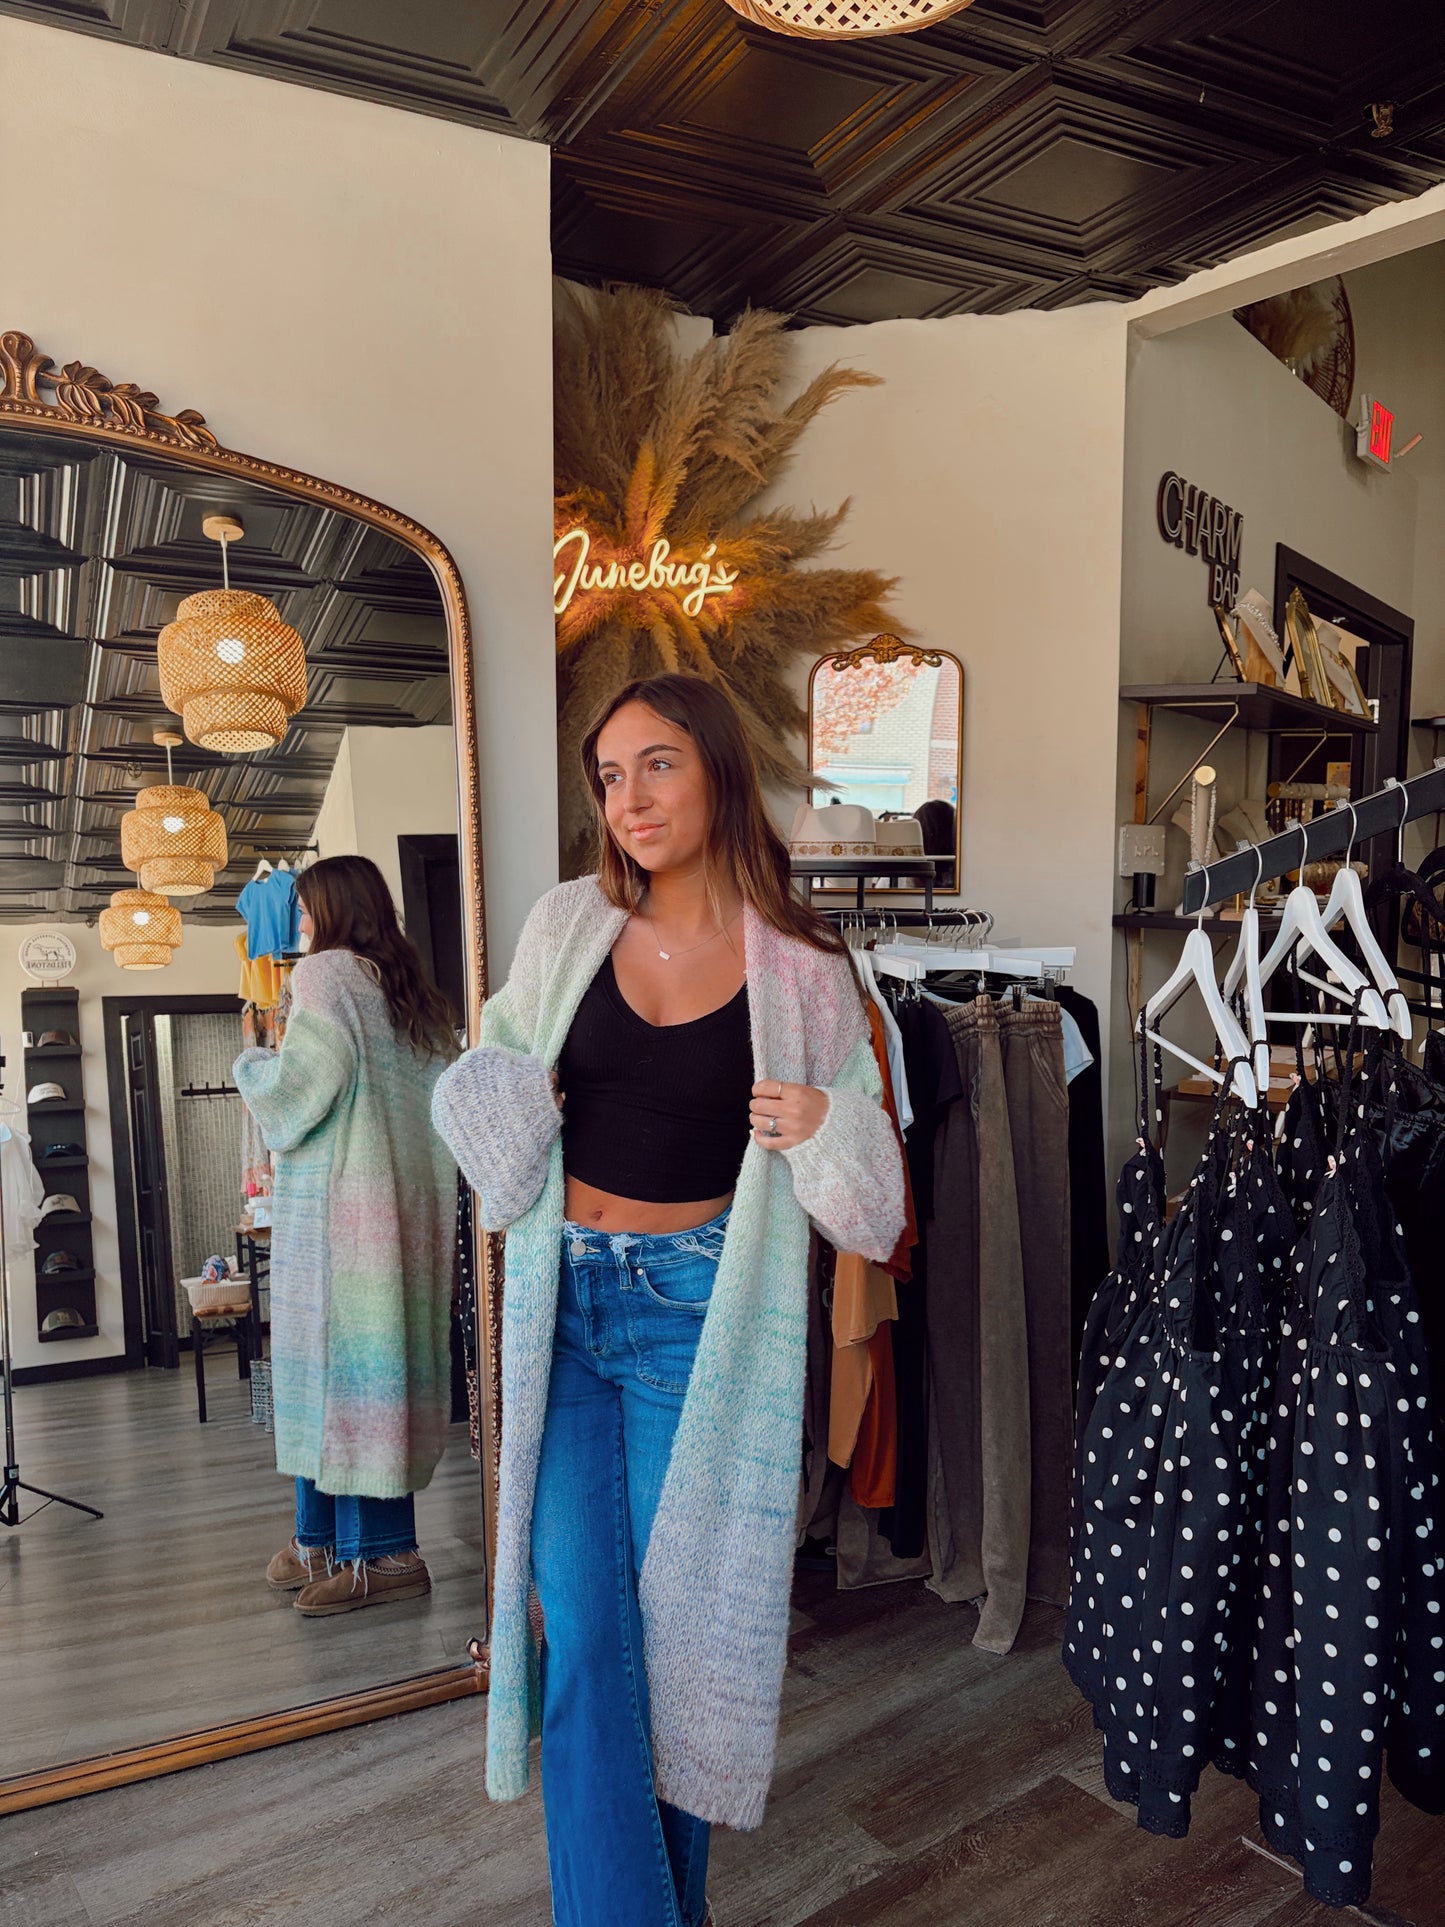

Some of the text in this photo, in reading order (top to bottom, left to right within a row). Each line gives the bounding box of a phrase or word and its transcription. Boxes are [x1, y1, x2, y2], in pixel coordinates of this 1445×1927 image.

[1158, 471, 1244, 567] CHARM
[553, 528, 740, 617] Junebug's
[1210, 564, 1240, 610] BAR
